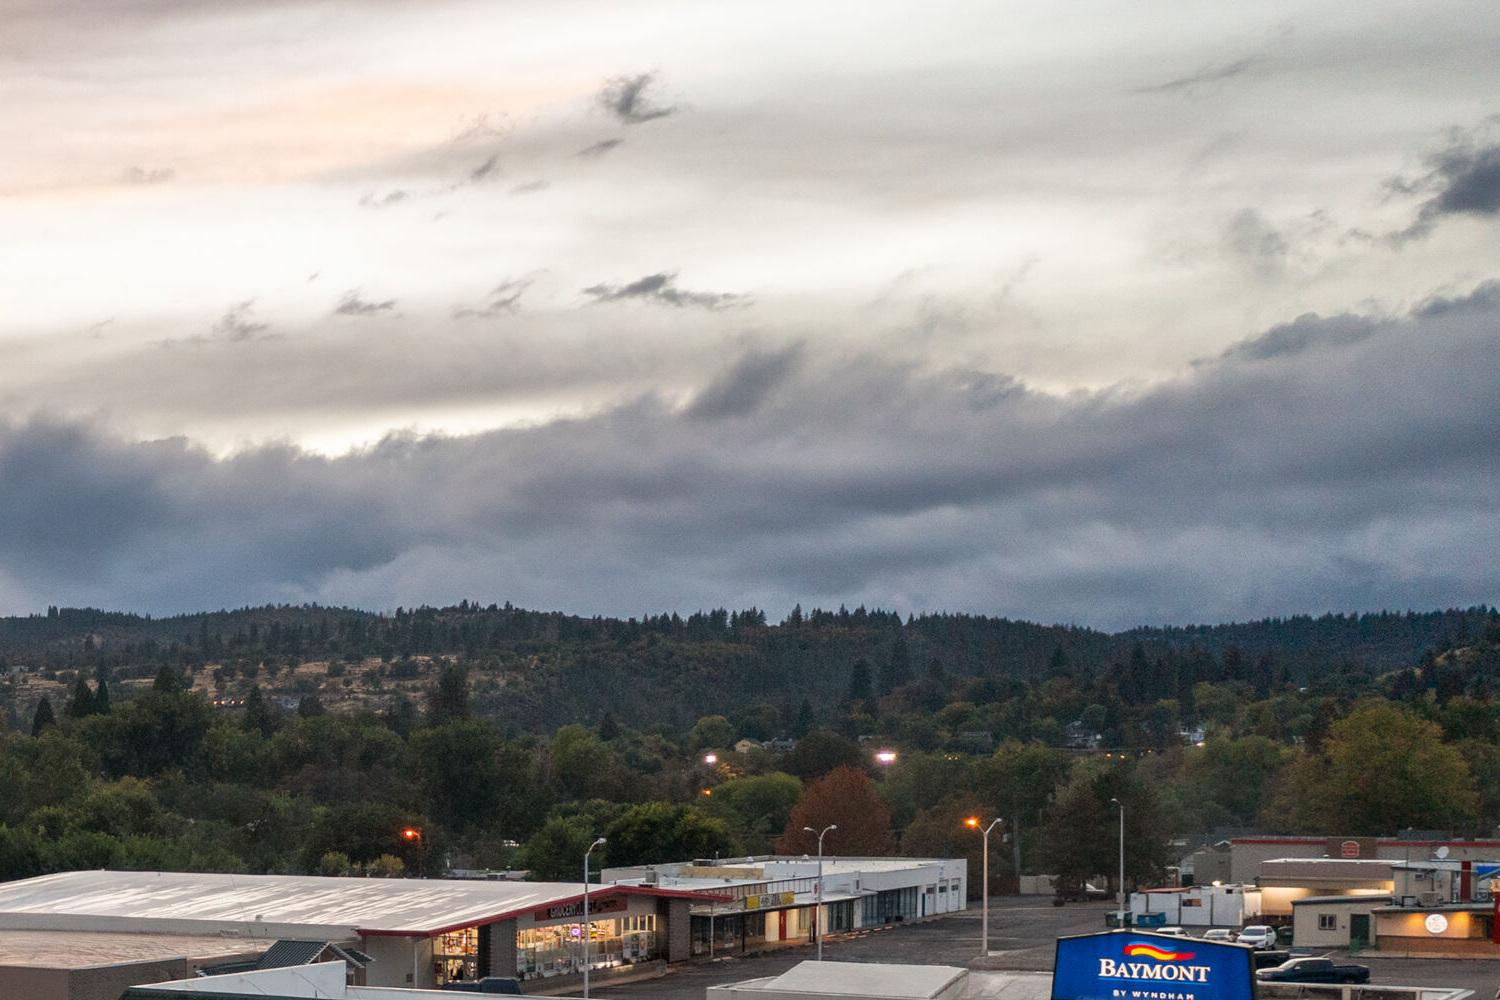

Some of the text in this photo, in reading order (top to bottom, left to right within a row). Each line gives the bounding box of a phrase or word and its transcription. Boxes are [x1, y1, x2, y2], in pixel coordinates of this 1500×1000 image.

[1098, 958, 1211, 982] BAYMONT
[1112, 989, 1194, 1000] BY WYNDHAM
